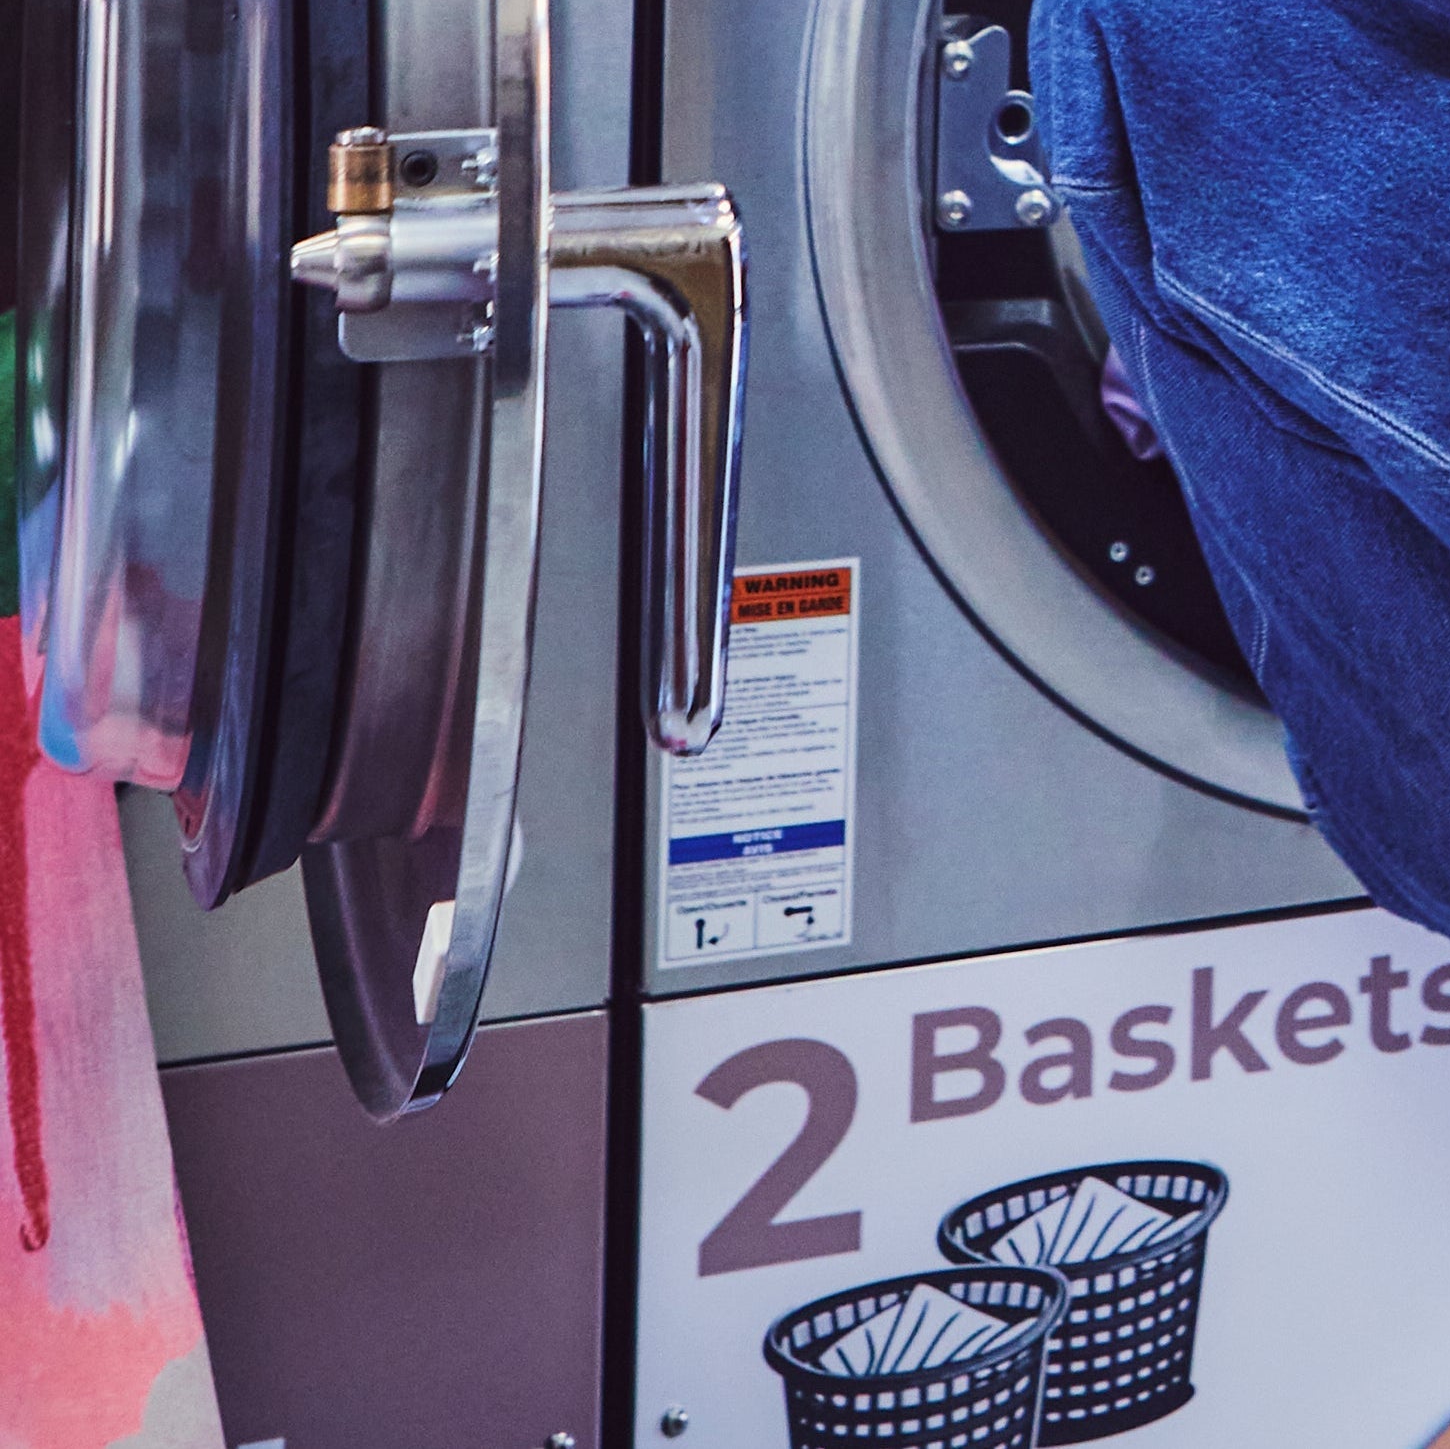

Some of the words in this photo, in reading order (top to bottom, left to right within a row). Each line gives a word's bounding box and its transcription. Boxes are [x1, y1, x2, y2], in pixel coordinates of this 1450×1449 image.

[746, 573, 839, 593] WARNING
[738, 602, 771, 617] MISE
[777, 601, 794, 614] EN
[799, 596, 843, 612] GARDE
[694, 1038, 863, 1278] 2
